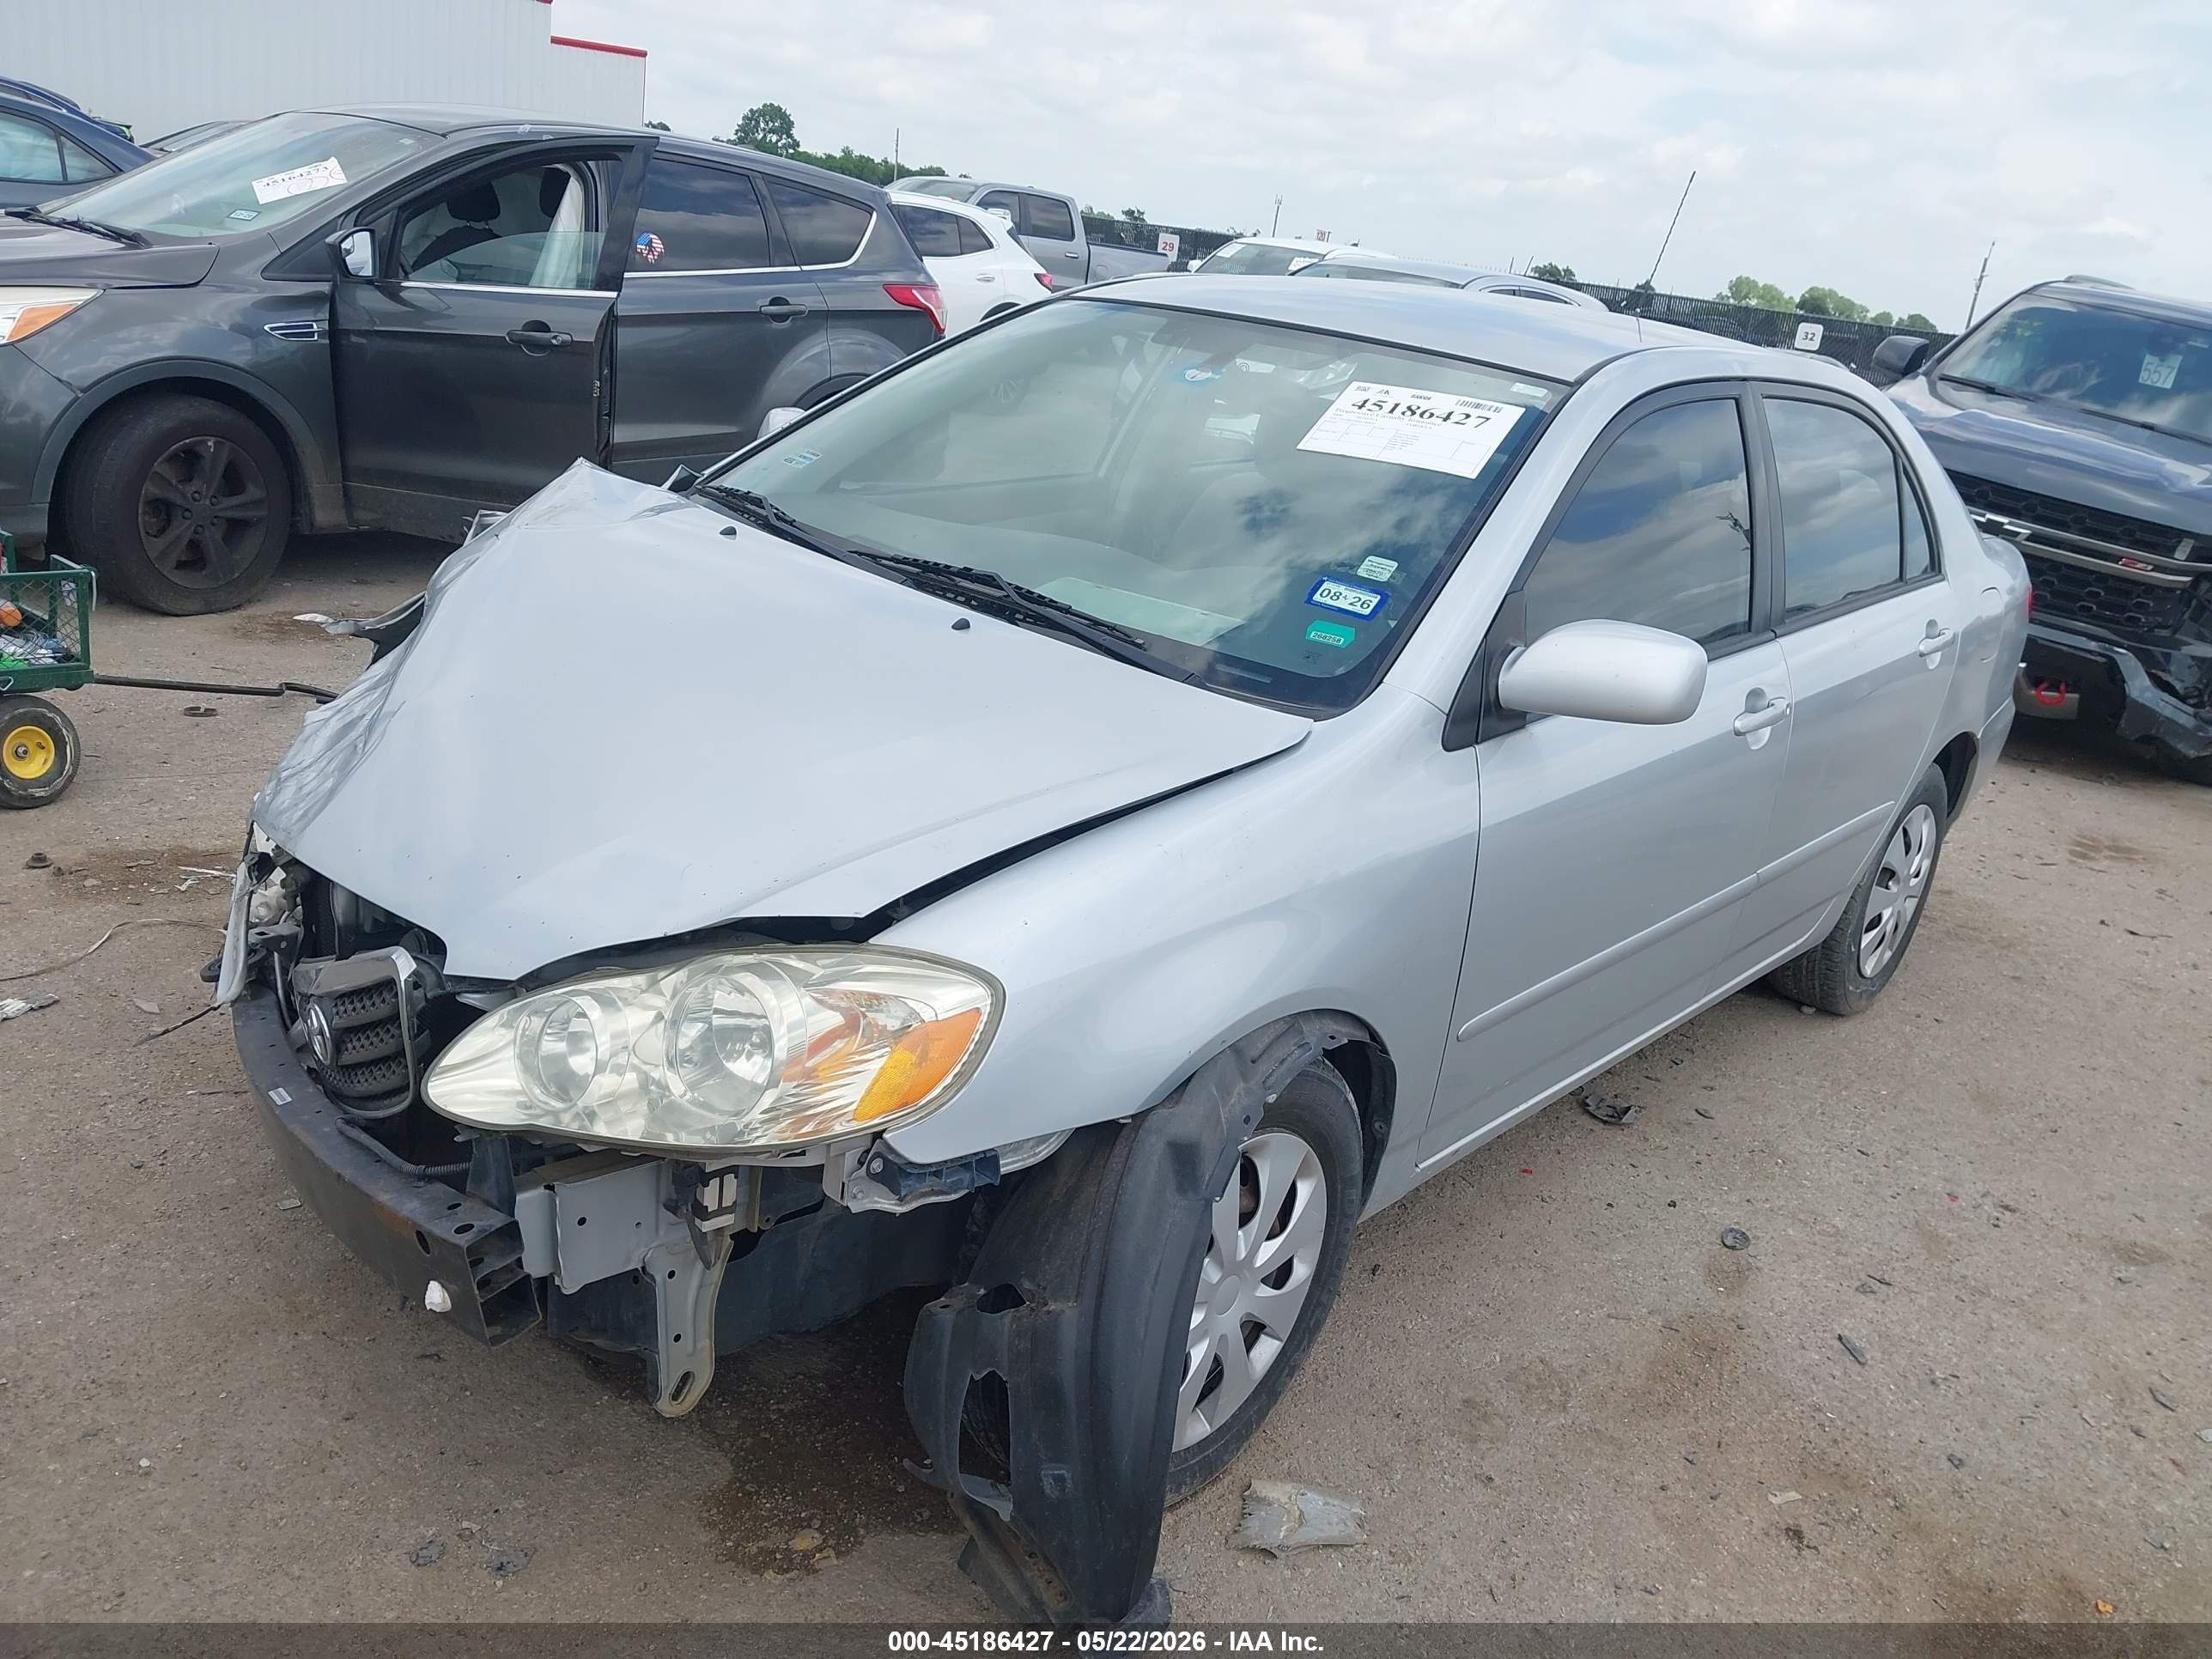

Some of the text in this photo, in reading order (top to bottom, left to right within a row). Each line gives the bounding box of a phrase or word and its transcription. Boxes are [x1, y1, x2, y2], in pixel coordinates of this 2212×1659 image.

[1161, 241, 1175, 252] 29
[1802, 331, 1816, 342] 32
[2141, 362, 2176, 385] 557
[1351, 398, 1492, 428] 45186427
[1319, 587, 1343, 602] 08
[1347, 596, 1373, 610] 26
